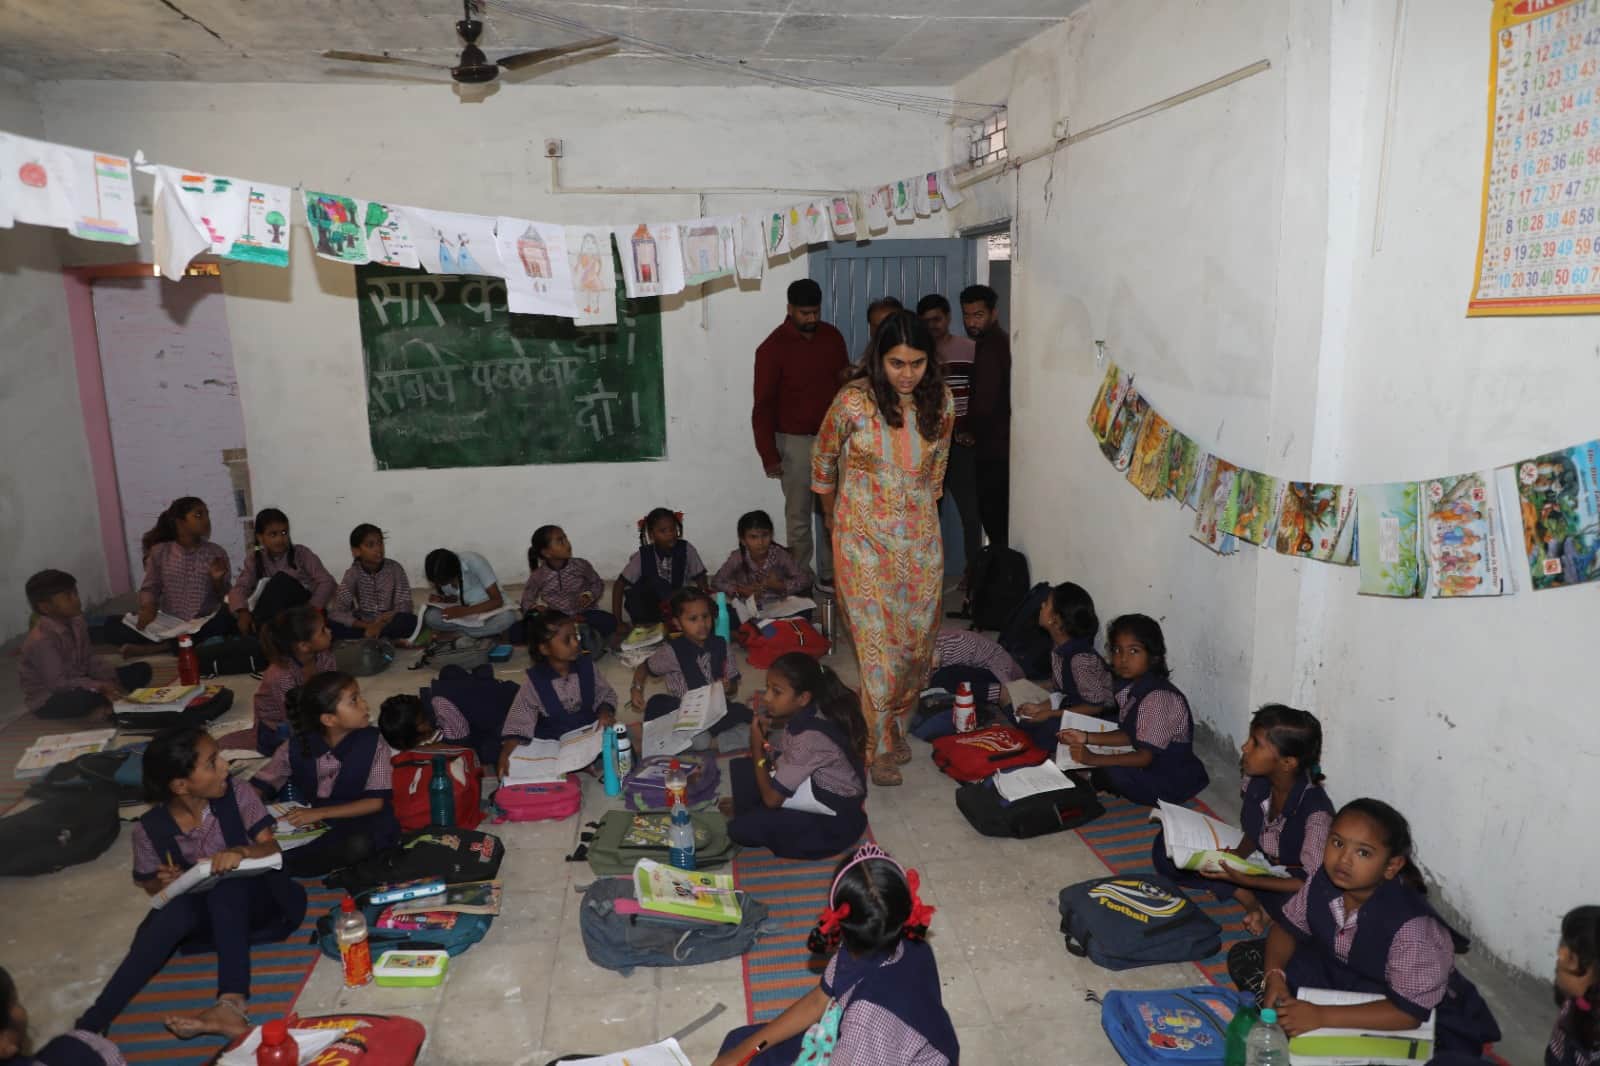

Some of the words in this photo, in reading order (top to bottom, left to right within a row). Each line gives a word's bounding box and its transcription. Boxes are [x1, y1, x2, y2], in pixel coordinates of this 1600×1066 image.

[1526, 22, 1531, 39] 1
[1540, 16, 1552, 32] 11
[1556, 10, 1568, 31] 21
[1574, 5, 1586, 22] 31
[1523, 51, 1532, 67] 2
[1536, 45, 1550, 63] 12
[1551, 38, 1567, 58] 22
[1567, 33, 1583, 53] 32
[1584, 27, 1600, 46] 42
[1520, 79, 1529, 97] 3
[1534, 75, 1546, 92] 13
[1547, 69, 1561, 88] 23
[1564, 63, 1578, 81] 33
[1580, 59, 1596, 76] 43
[1516, 107, 1525, 124] 4
[1529, 103, 1541, 119] 14
[1543, 98, 1557, 116] 24
[1560, 94, 1573, 112] 34
[1576, 87, 1592, 106] 44
[1514, 135, 1522, 152] 5
[1526, 129, 1538, 149] 15
[1540, 127, 1554, 146] 25
[1557, 124, 1570, 142] 35
[1573, 120, 1589, 137] 45
[1511, 163, 1519, 180] 6
[1523, 160, 1535, 177] 16
[1536, 158, 1550, 175] 26
[1552, 152, 1567, 171] 36
[1569, 149, 1584, 166] 46
[1587, 146, 1600, 166] 56
[1509, 190, 1516, 206] 7
[1520, 187, 1532, 205] 17
[1533, 184, 1548, 203] 27
[1549, 182, 1564, 200] 37
[1566, 179, 1581, 196] 47
[1584, 176, 1600, 195] 57
[1506, 218, 1513, 235] 8
[1518, 216, 1529, 233] 18
[1530, 214, 1544, 231] 28
[1545, 210, 1560, 229] 38
[1561, 208, 1577, 226] 48
[1578, 207, 1594, 225] 58
[1503, 246, 1511, 262] 9
[1515, 244, 1527, 260] 19
[1529, 242, 1541, 259] 29
[1543, 240, 1556, 258] 39
[1558, 239, 1573, 256] 49
[1575, 238, 1591, 255] 59
[1499, 272, 1510, 289] 10
[1512, 271, 1524, 289] 20
[1526, 271, 1538, 288] 30
[1541, 269, 1553, 286] 40
[1555, 268, 1569, 285] 50
[1571, 266, 1588, 285] 60
[1099, 896, 1149, 924] Football
